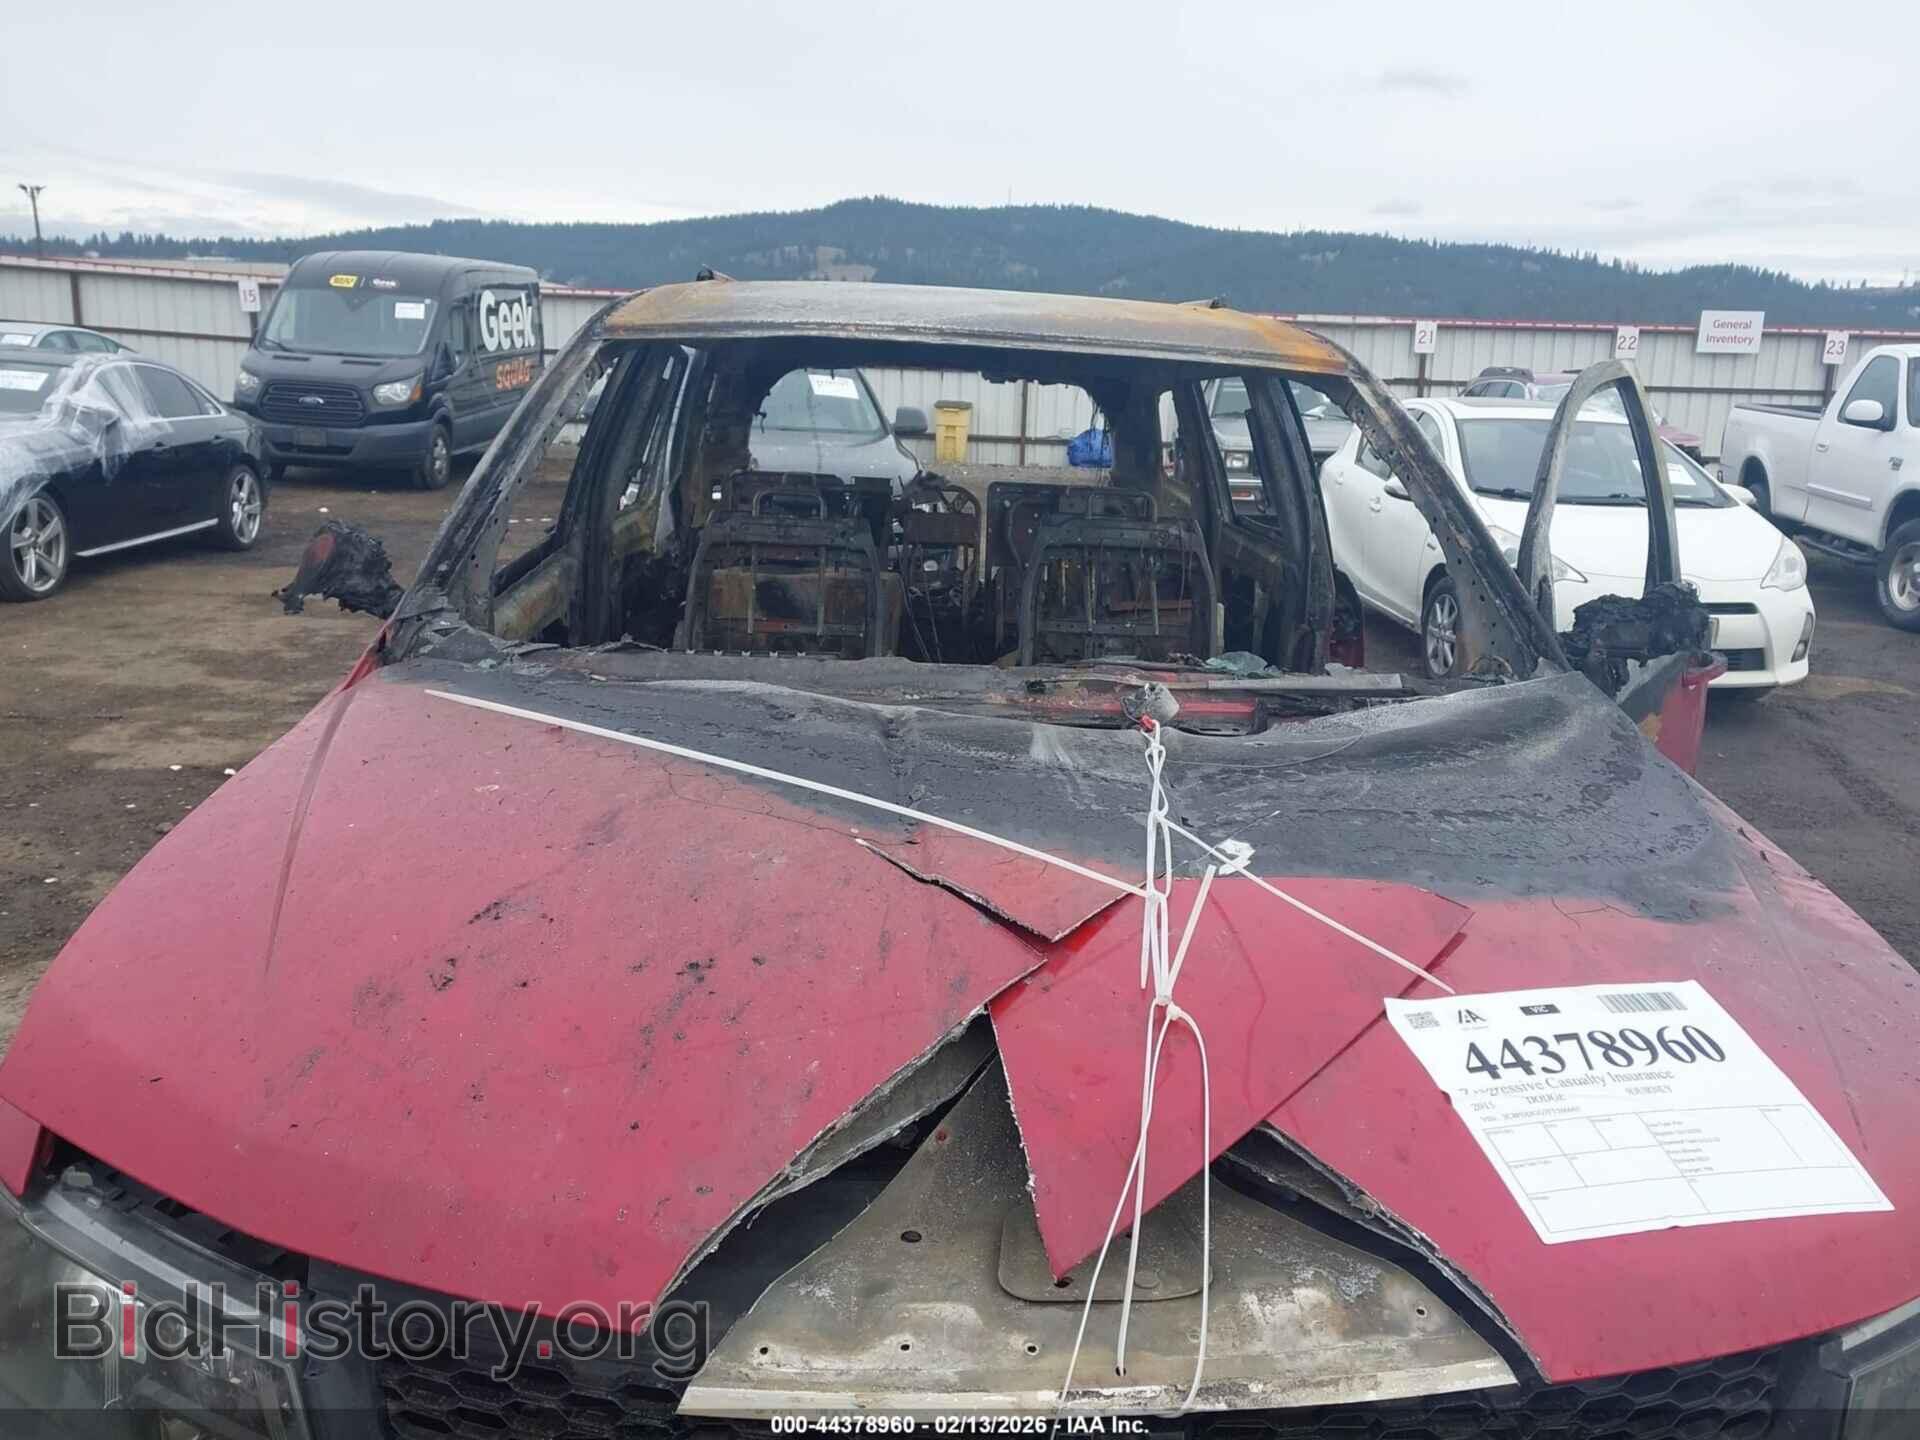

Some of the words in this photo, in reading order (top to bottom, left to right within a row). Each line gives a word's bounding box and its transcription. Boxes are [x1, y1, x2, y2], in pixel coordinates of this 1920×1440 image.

[242, 288, 257, 304] 15
[480, 289, 536, 352] Geek
[1713, 319, 1752, 329] General
[1418, 330, 1434, 344] 21
[1617, 335, 1637, 350] 22
[1706, 334, 1754, 346] Inventory
[1826, 340, 1845, 356] 23
[1466, 1024, 1726, 1080] 44378960
[1546, 1074, 1606, 1090] Casualty
[1608, 1070, 1674, 1084] Insurance
